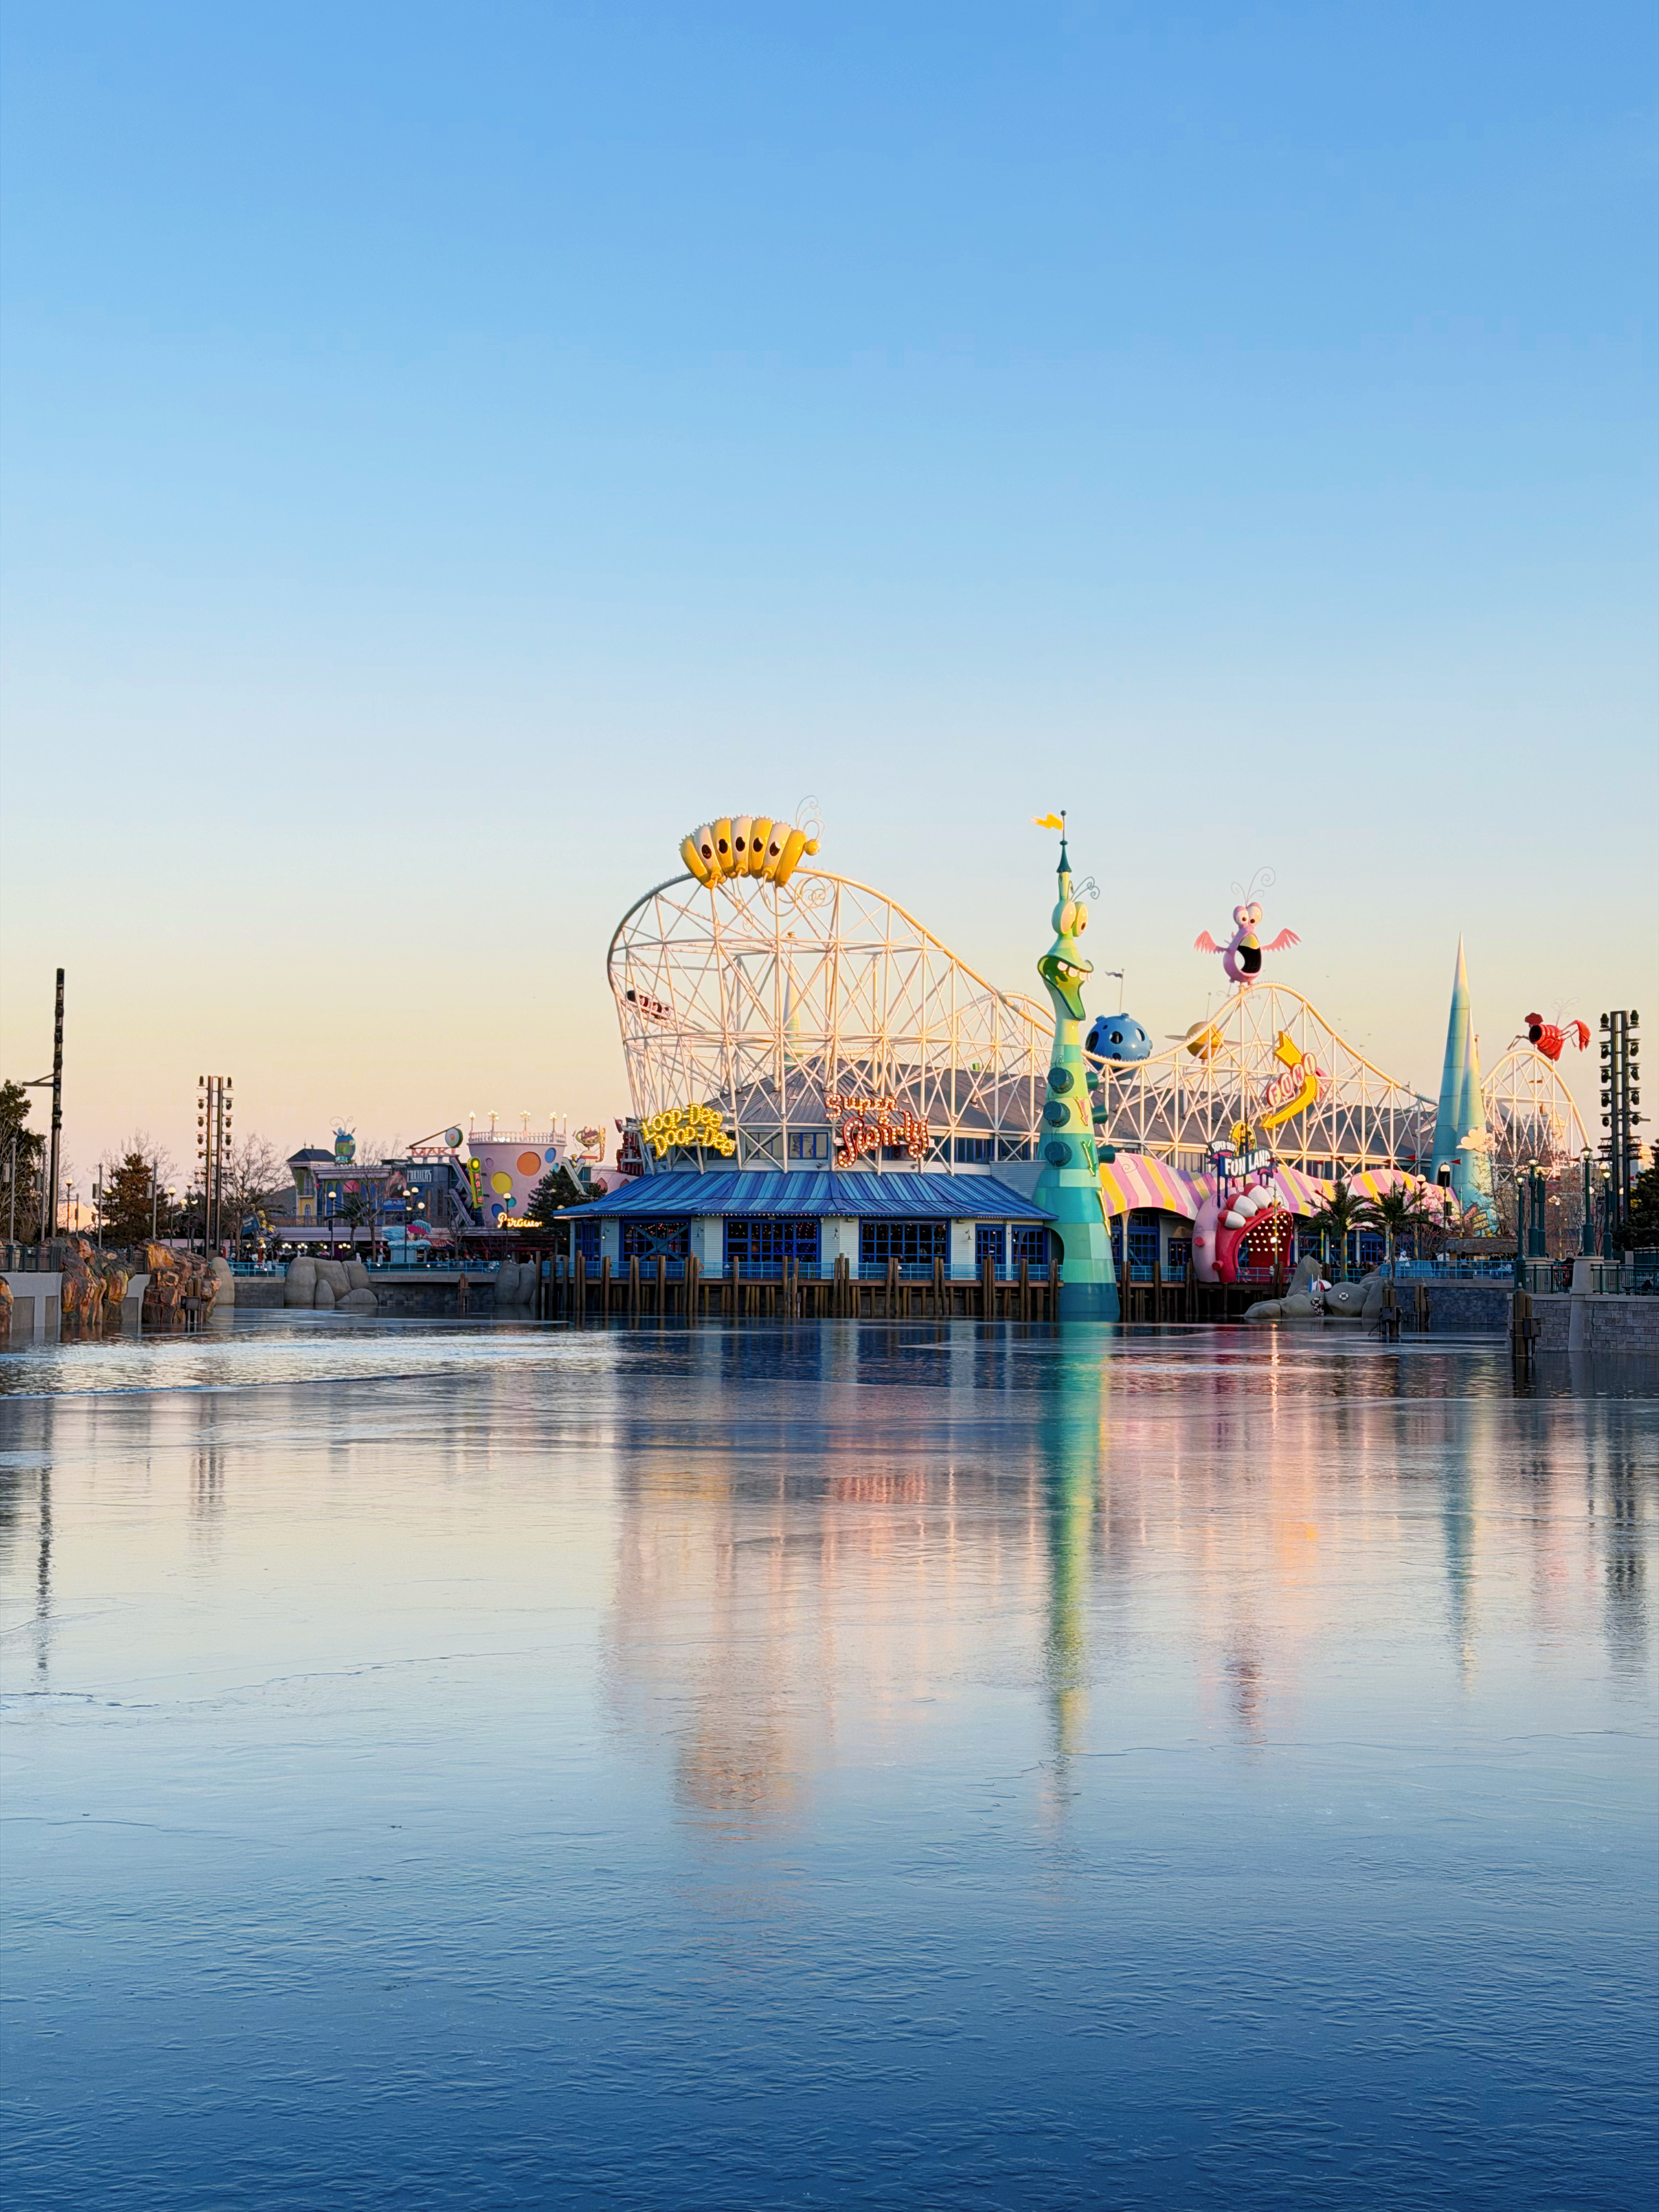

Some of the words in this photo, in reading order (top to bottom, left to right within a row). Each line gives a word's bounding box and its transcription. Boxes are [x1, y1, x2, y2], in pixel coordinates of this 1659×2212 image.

[1269, 1054, 1314, 1107] FUN!
[825, 1093, 900, 1118] Super
[1211, 1141, 1226, 1153] SUPER
[1224, 1156, 1246, 1176] FUN
[1248, 1149, 1271, 1172] LAND
